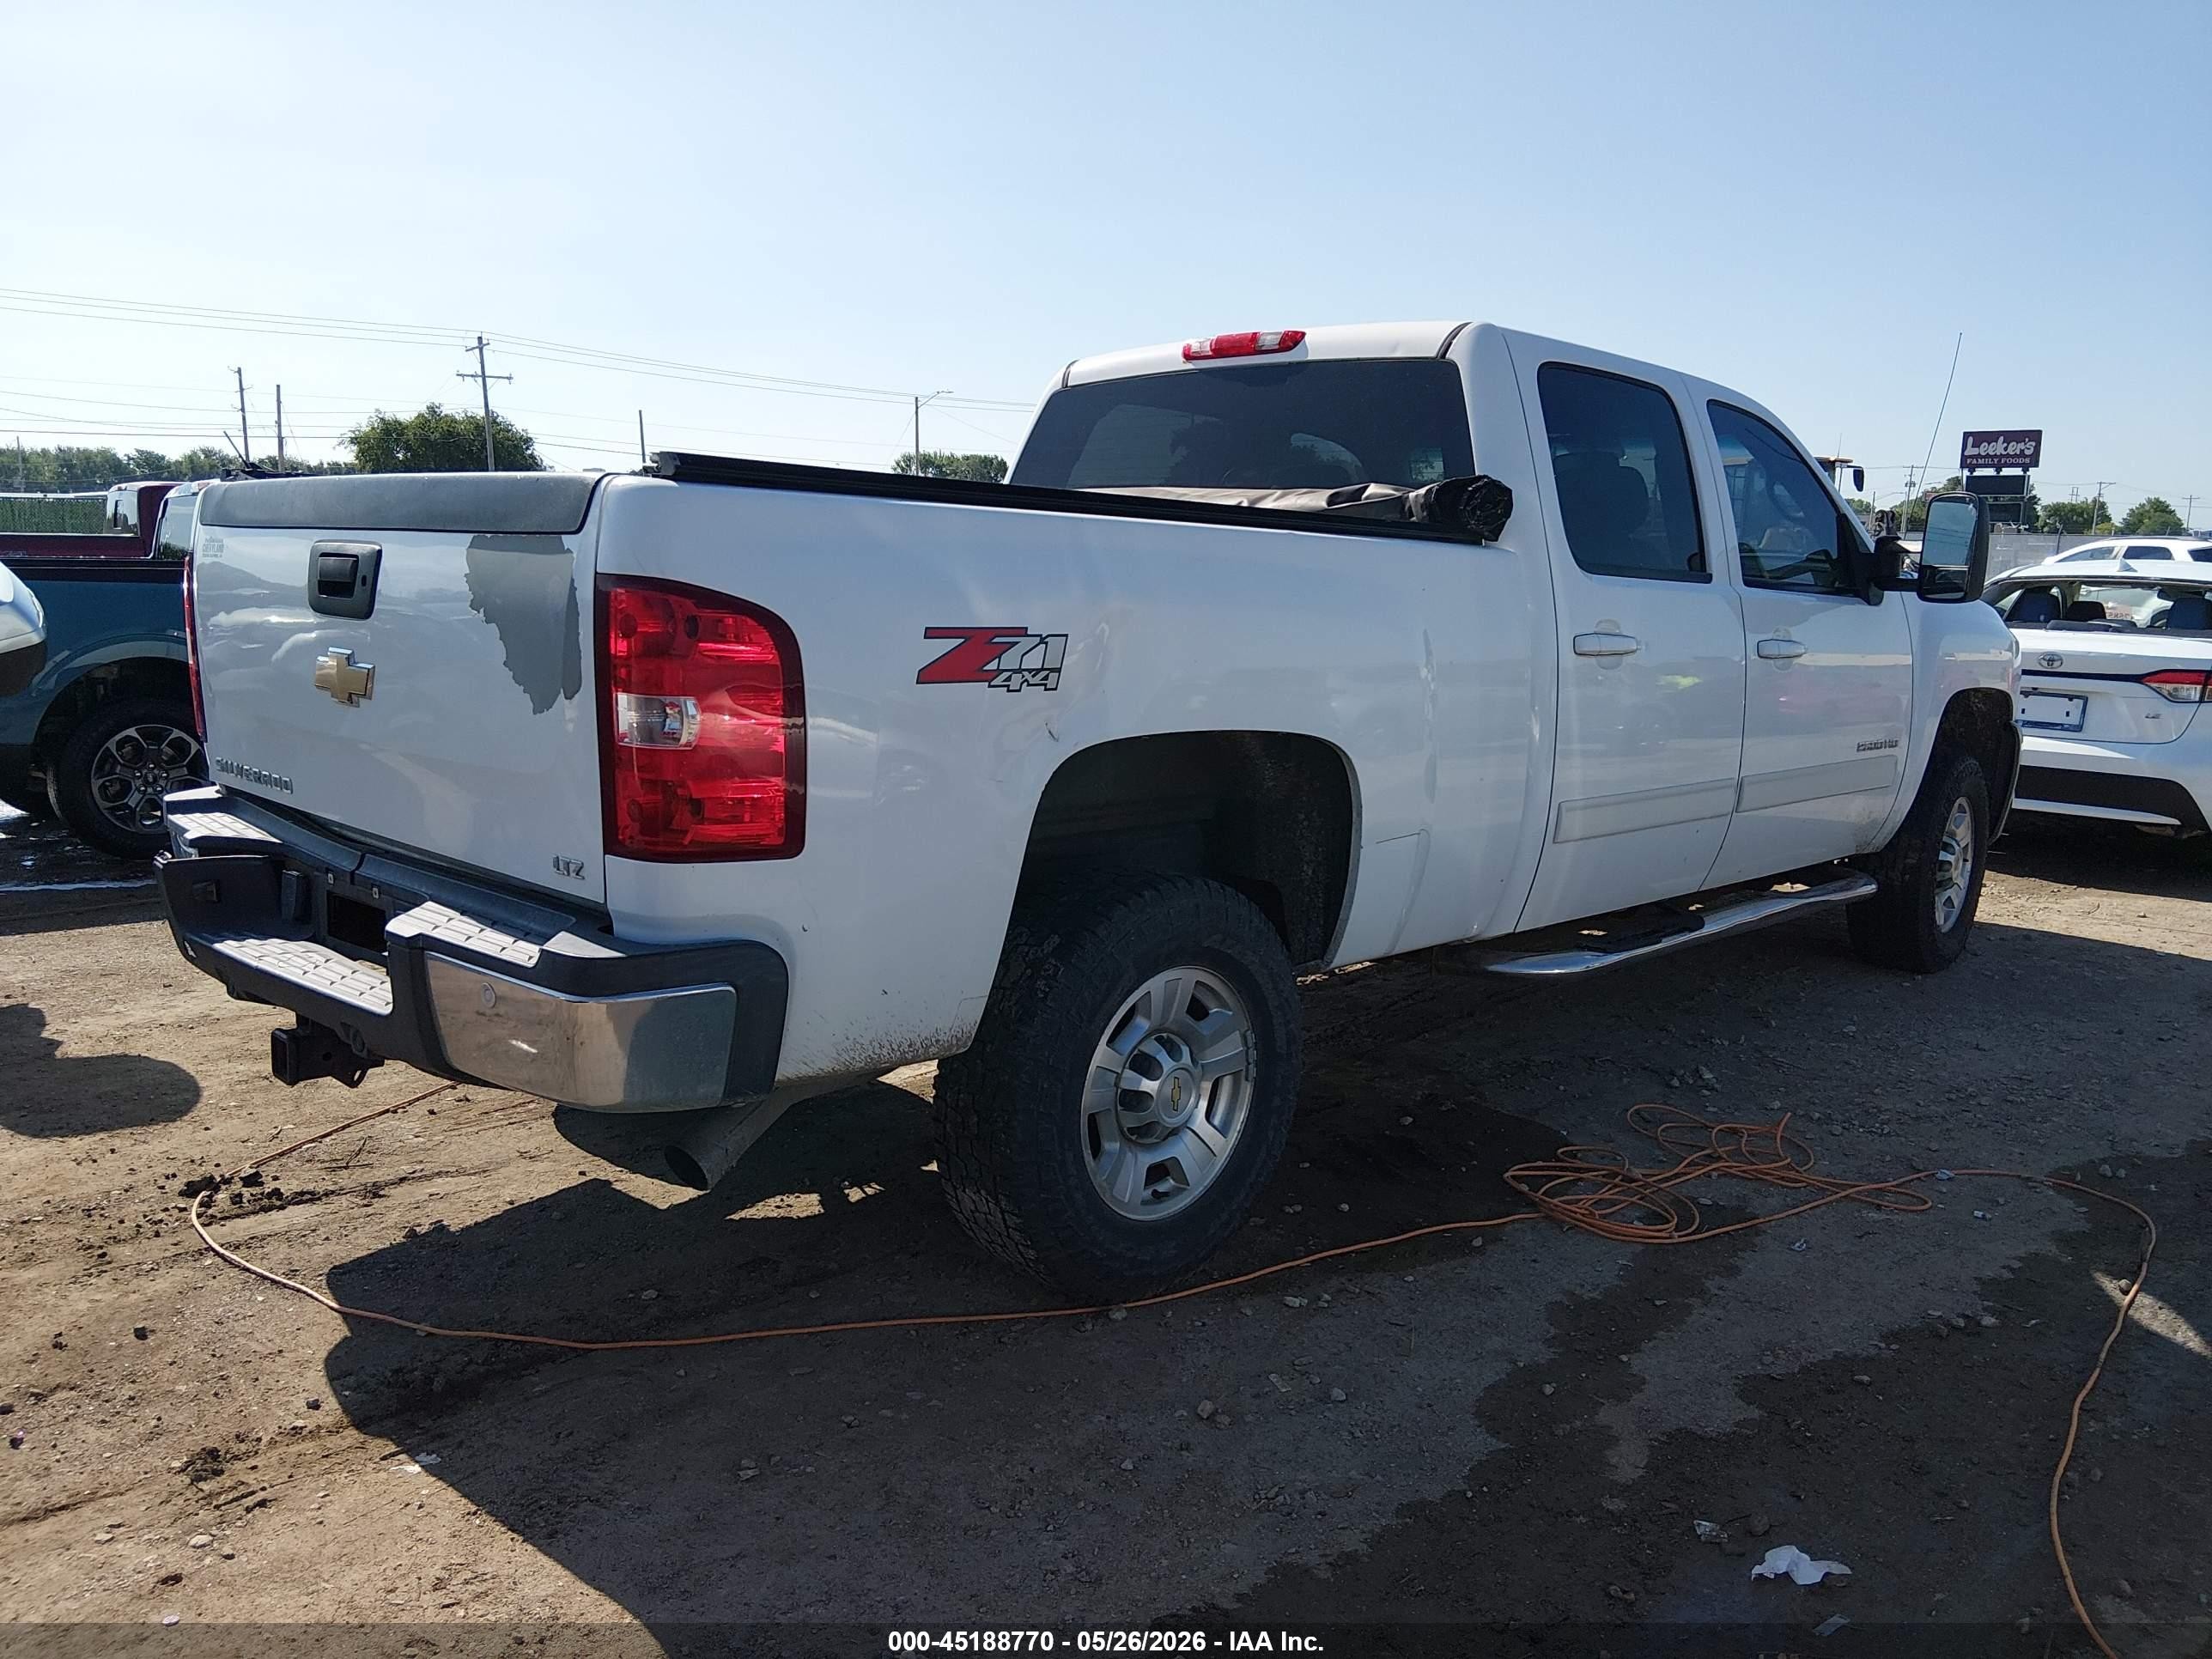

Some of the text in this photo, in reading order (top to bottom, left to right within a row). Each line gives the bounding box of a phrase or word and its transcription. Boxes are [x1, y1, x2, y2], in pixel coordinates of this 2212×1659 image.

[1964, 435, 2036, 456] Leeker's
[1966, 457, 1999, 465] FAMILY
[915, 626, 1069, 685] Z71
[215, 757, 295, 794] SILVERADO
[552, 855, 586, 880] LTZ
